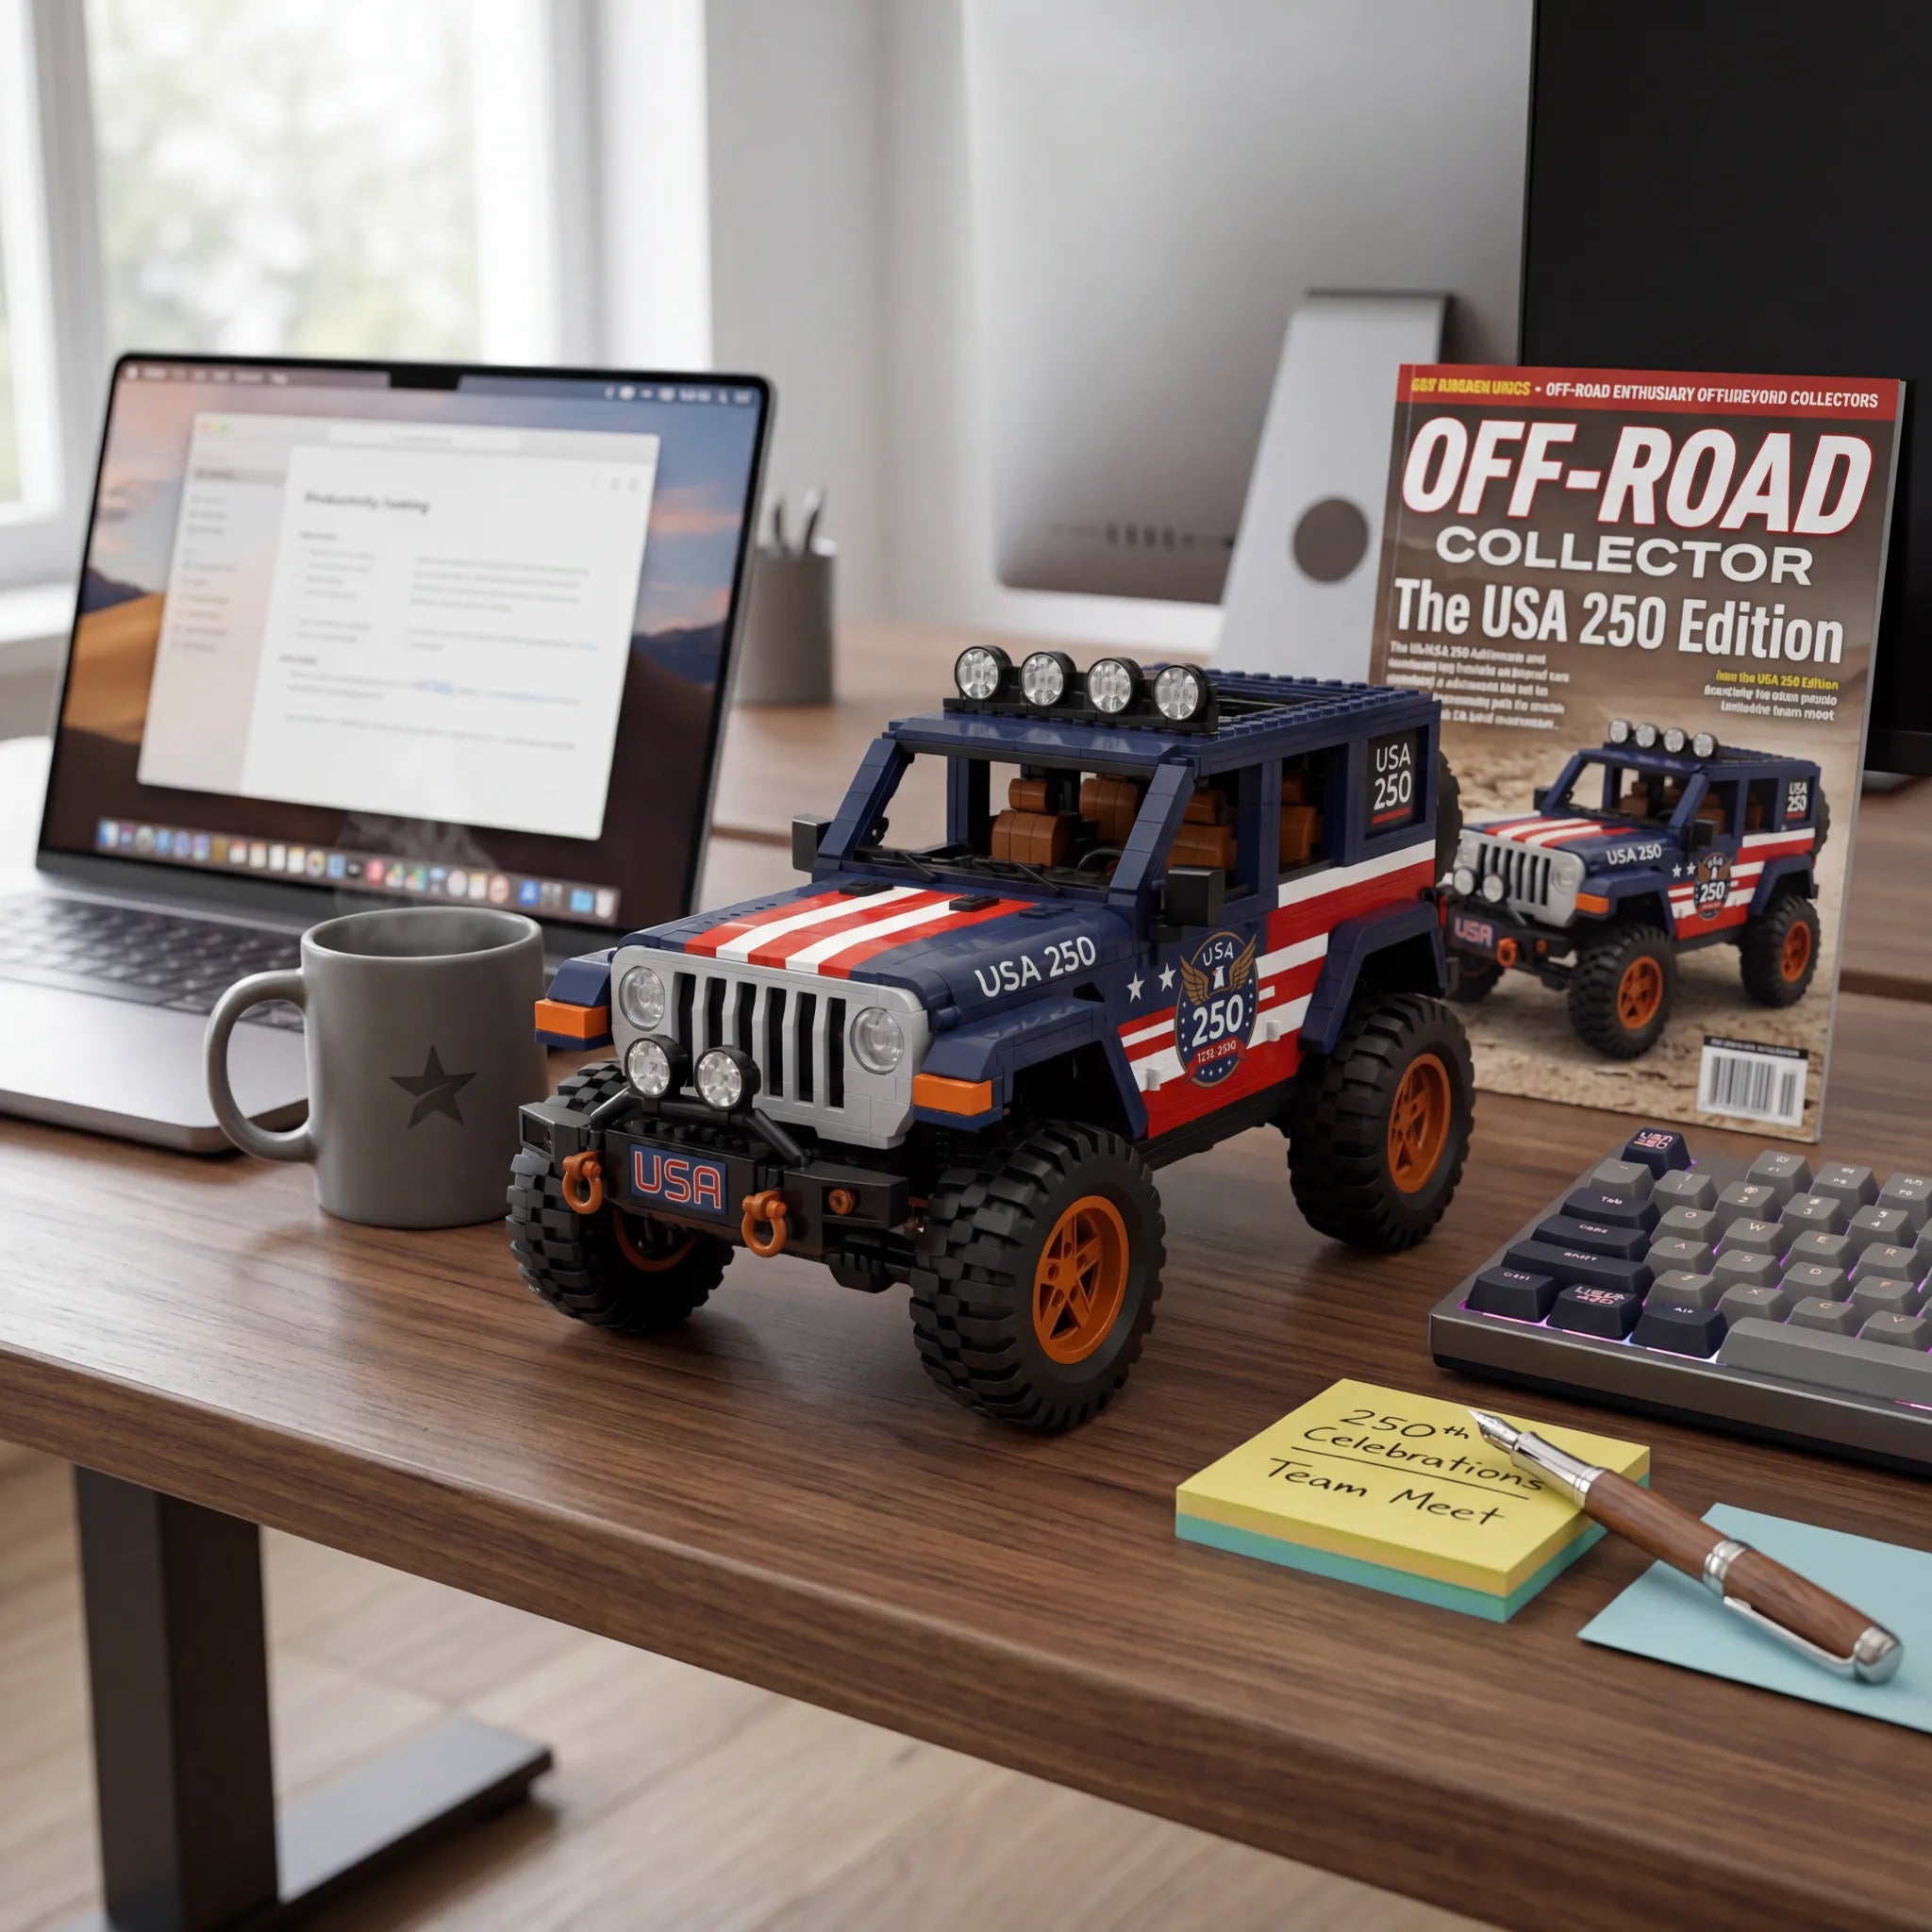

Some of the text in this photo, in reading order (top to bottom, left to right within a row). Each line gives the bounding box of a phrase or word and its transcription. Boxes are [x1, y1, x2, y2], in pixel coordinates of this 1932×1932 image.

[1546, 382, 1610, 398] OFF-ROAD
[1613, 385, 1695, 402] ENTHUSIARY
[1790, 391, 1878, 408] COLLECTORS
[1402, 416, 1873, 536] OFF-ROAD
[1435, 525, 1813, 586] COLLECTOR
[1394, 577, 1845, 664] The USA 250 Edition
[1780, 675, 1799, 687] 250
[1376, 742, 1411, 773] USA
[1374, 770, 1412, 810] 250
[1606, 843, 1662, 865] USA 250
[1699, 881, 1725, 904] 250
[1455, 917, 1492, 947] USA
[974, 936, 1096, 997] USA 250
[1202, 941, 1234, 966] USA
[1191, 994, 1243, 1047] 250
[634, 1151, 721, 1209] USA
[1750, 1223, 1765, 1231] W
[1339, 1409, 1469, 1440] 250th
[1303, 1426, 1548, 1491] Celebrations
[1266, 1457, 1507, 1526] Team Meet
